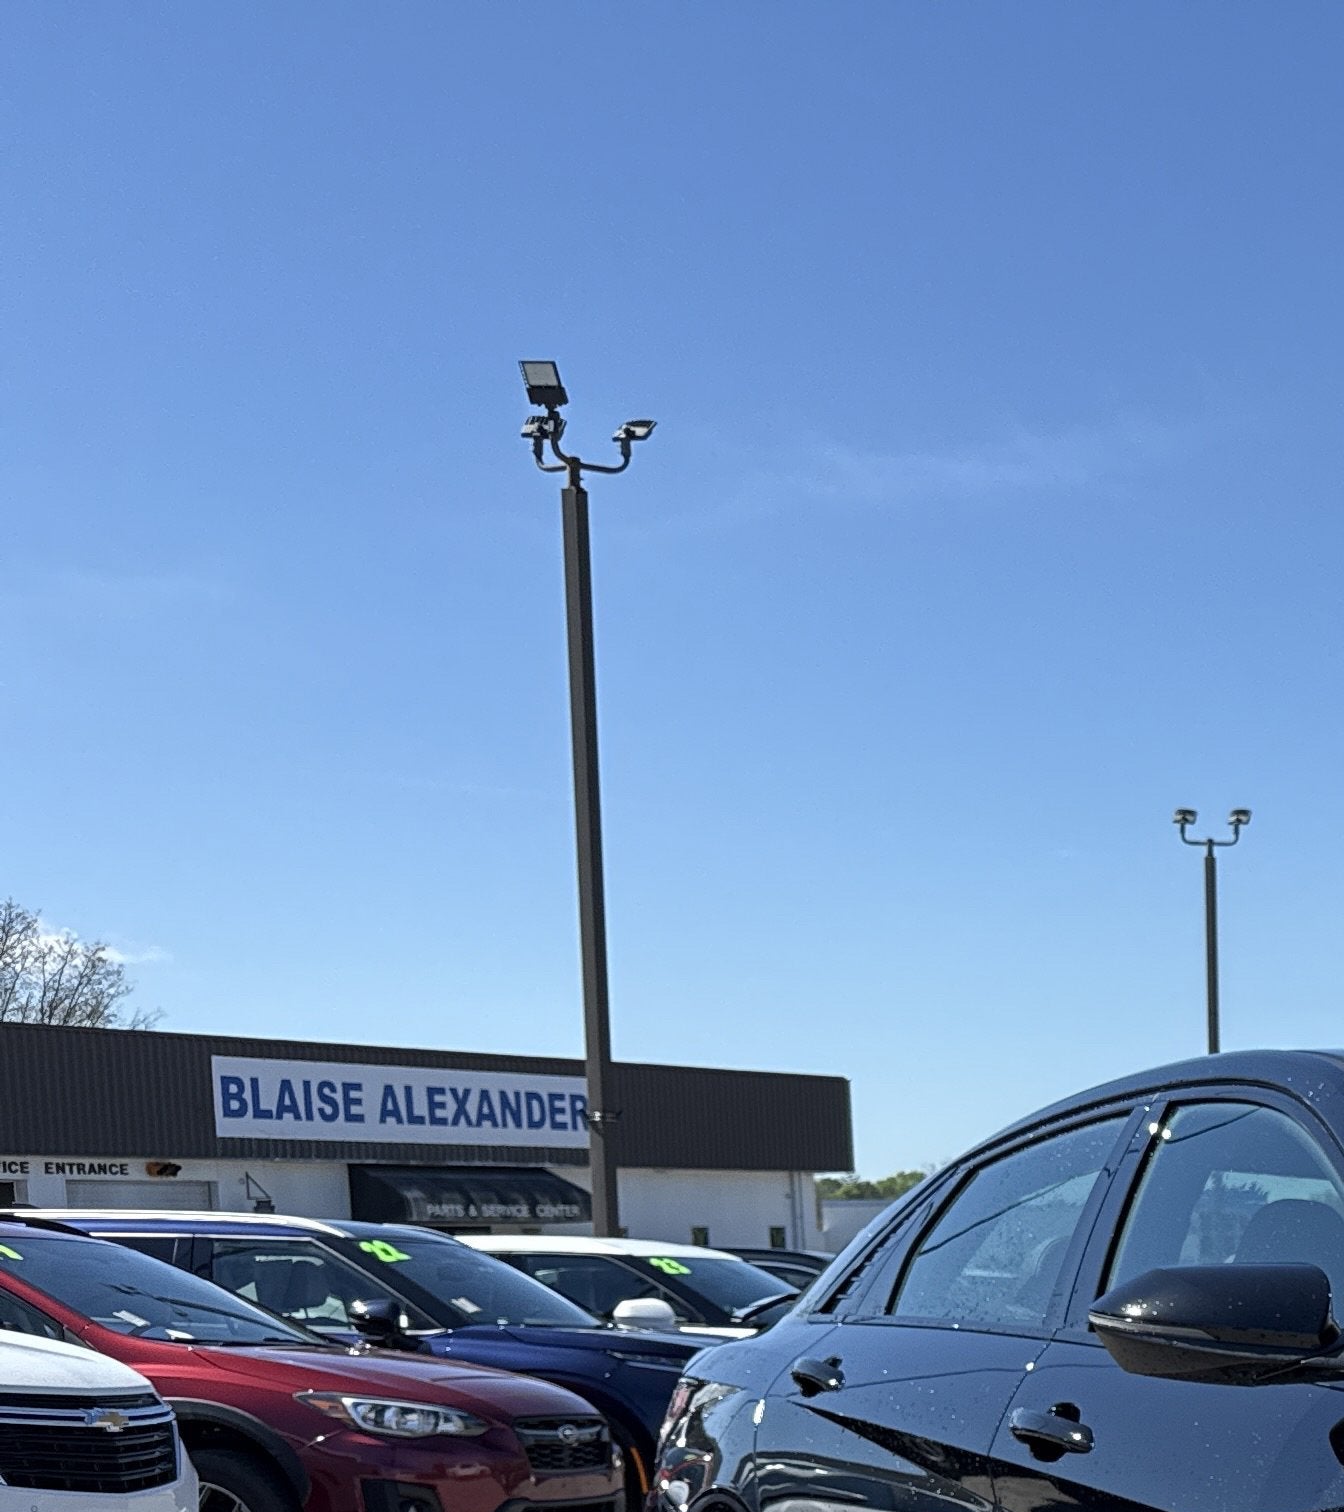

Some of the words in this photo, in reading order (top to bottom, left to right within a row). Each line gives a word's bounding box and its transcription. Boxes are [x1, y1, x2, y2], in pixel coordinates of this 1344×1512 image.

[220, 1075, 365, 1123] BLAISE
[379, 1084, 588, 1132] ALEXANDER
[0, 1161, 30, 1174] ICE
[44, 1161, 130, 1176] ENTRANCE
[426, 1203, 466, 1218] PARTS
[481, 1203, 530, 1218] SERVICE
[535, 1203, 581, 1218] CENTER
